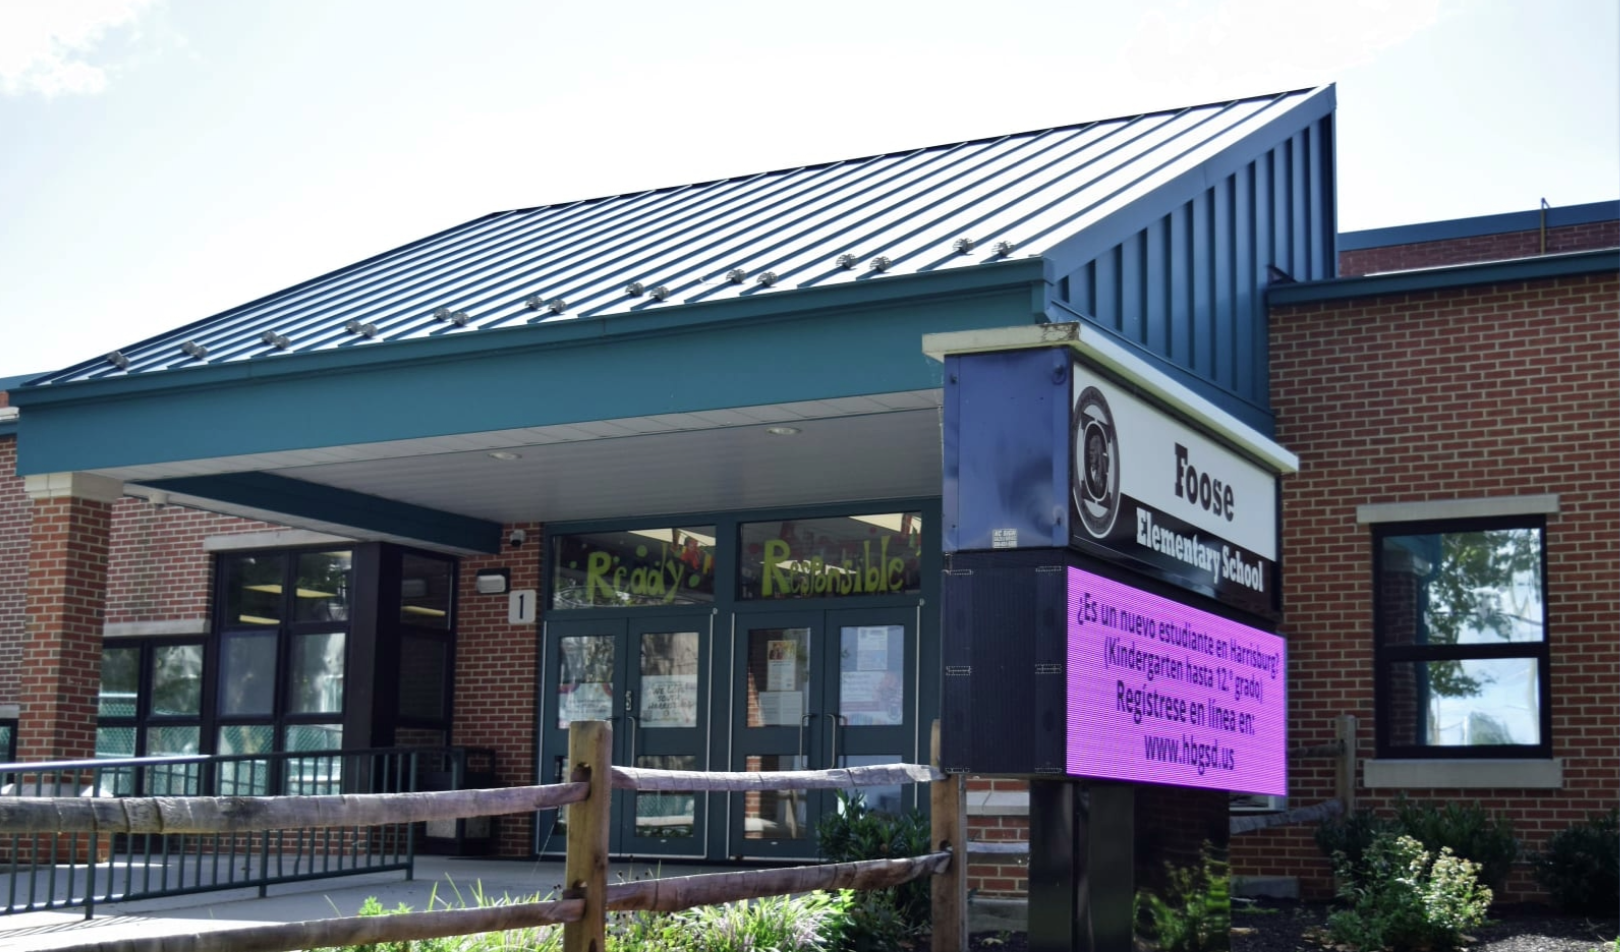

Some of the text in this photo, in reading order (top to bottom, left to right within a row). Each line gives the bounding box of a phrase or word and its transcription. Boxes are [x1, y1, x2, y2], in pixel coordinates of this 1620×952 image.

[1175, 442, 1234, 522] Foose
[587, 543, 684, 603] Ready
[762, 536, 905, 596] Responsible
[1136, 507, 1263, 592] Elementary School
[518, 594, 525, 619] 1
[1077, 593, 1279, 679] ¿Es un nuevo estudiante en Harrisburg?
[1104, 636, 1183, 680] (Kindergarten
[1186, 657, 1212, 688] hasta
[1235, 674, 1262, 703] grado)
[1117, 680, 1255, 735] Regístrese en línea en:
[1145, 734, 1234, 775] www.hbgsd.us
